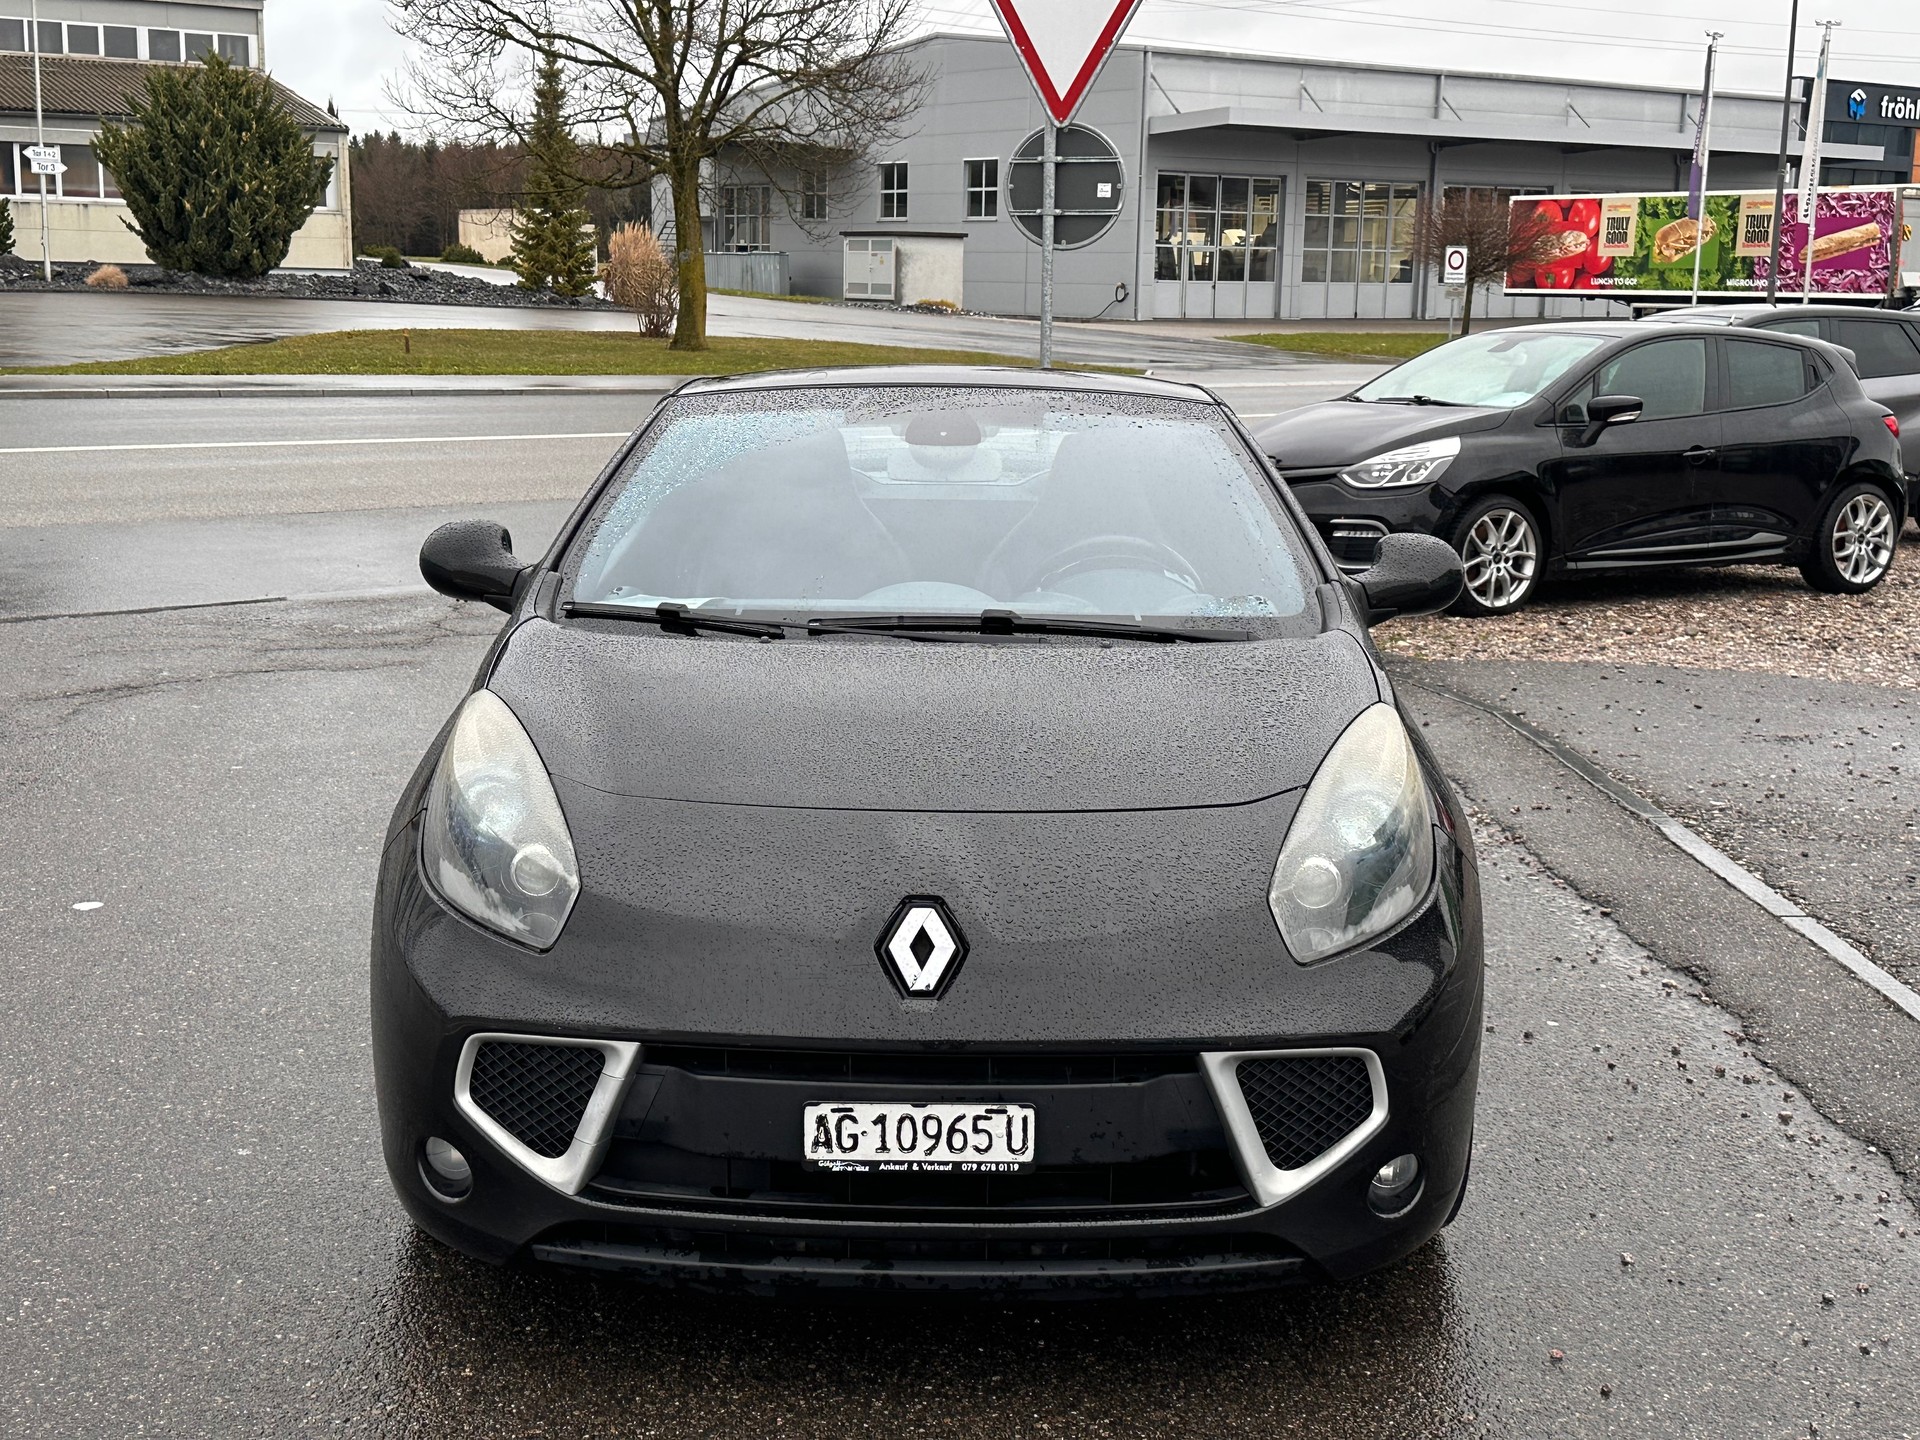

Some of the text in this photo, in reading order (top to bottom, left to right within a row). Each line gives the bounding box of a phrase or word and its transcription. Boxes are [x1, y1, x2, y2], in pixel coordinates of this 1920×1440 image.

[37, 163, 56, 171] Tor 3
[1606, 216, 1630, 231] TRULY
[1745, 214, 1772, 230] TRULY
[1605, 230, 1628, 244] GOOD
[1744, 229, 1769, 244] GOOD
[1613, 277, 1624, 286] TO
[878, 1162, 909, 1171] Ankauf
[912, 1163, 919, 1171] &
[922, 1162, 953, 1171] Verkauf
[961, 1163, 978, 1172] 079
[980, 1163, 997, 1172] 678
